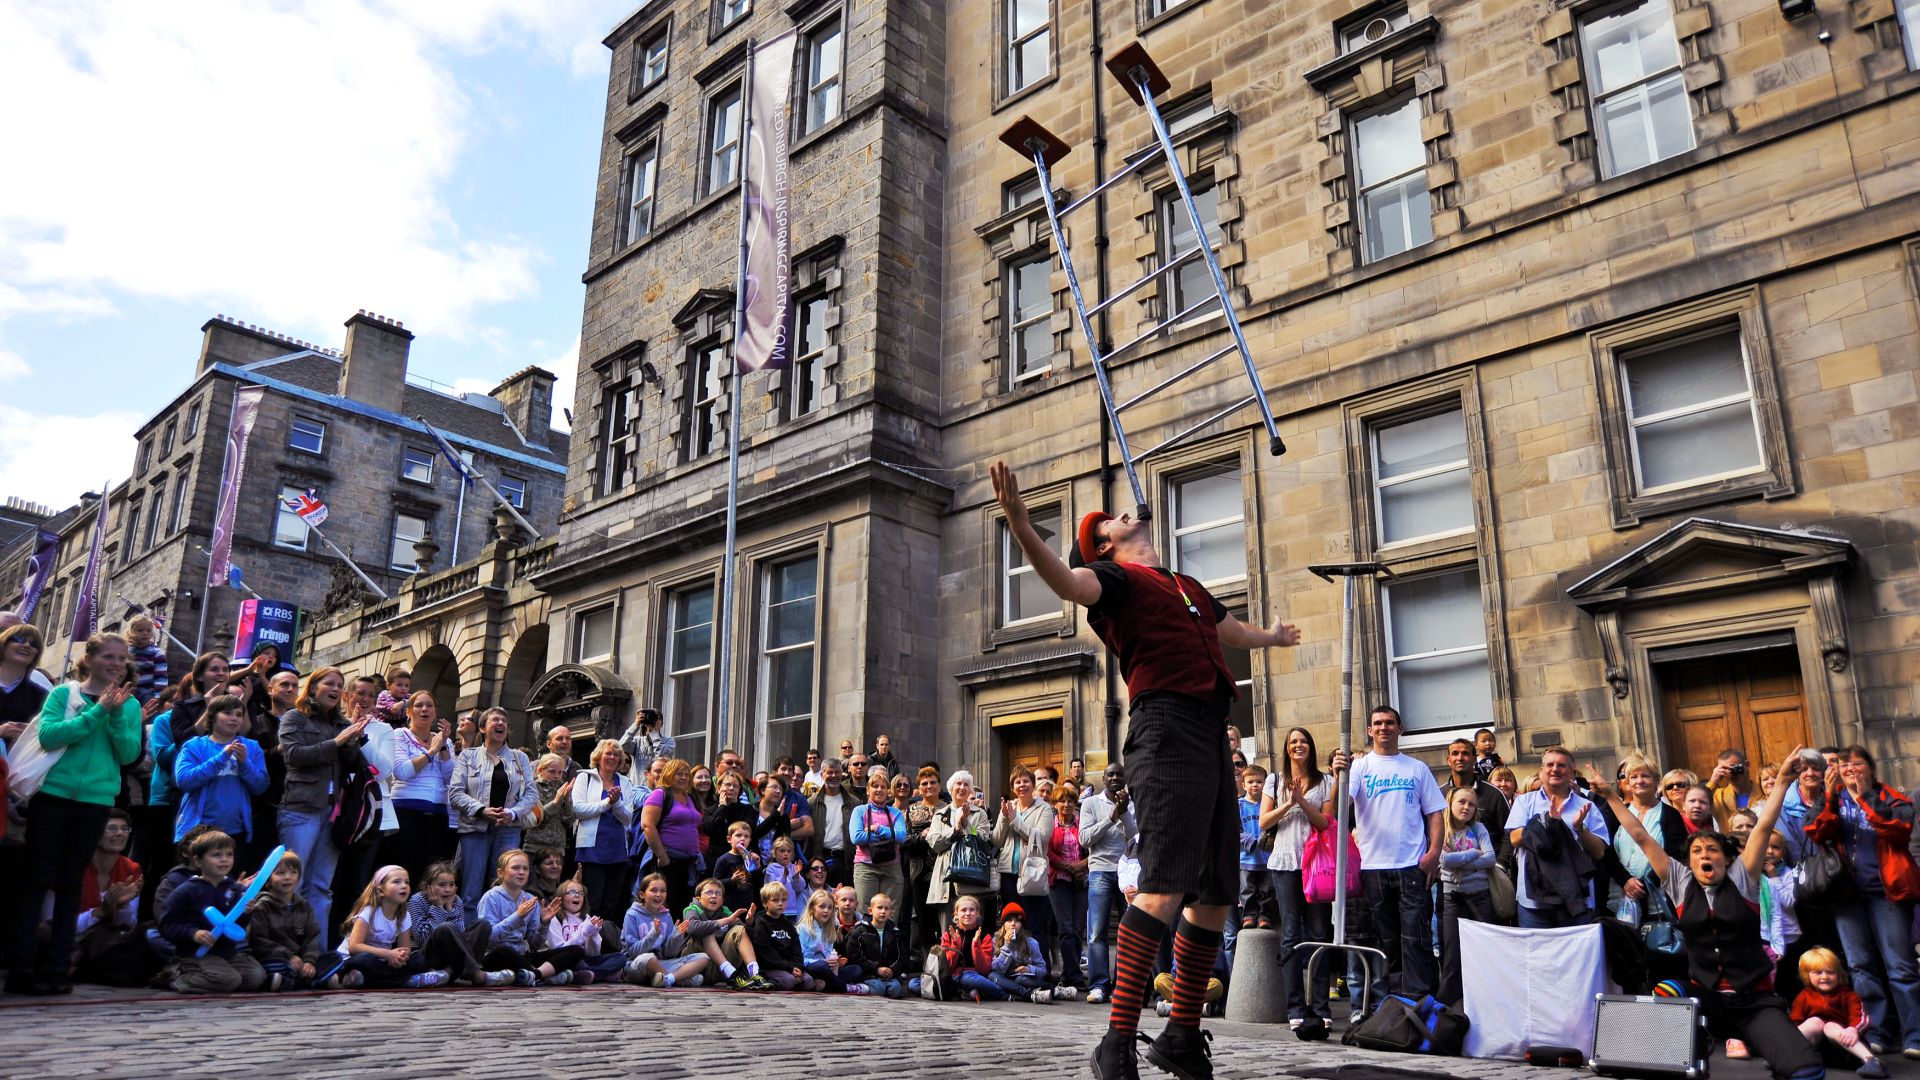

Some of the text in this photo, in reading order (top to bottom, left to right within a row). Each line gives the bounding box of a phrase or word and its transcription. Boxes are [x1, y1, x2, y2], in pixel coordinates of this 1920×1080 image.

[274, 607, 293, 621] RBS
[259, 627, 290, 644] fringe
[1364, 773, 1416, 799] Yankees
